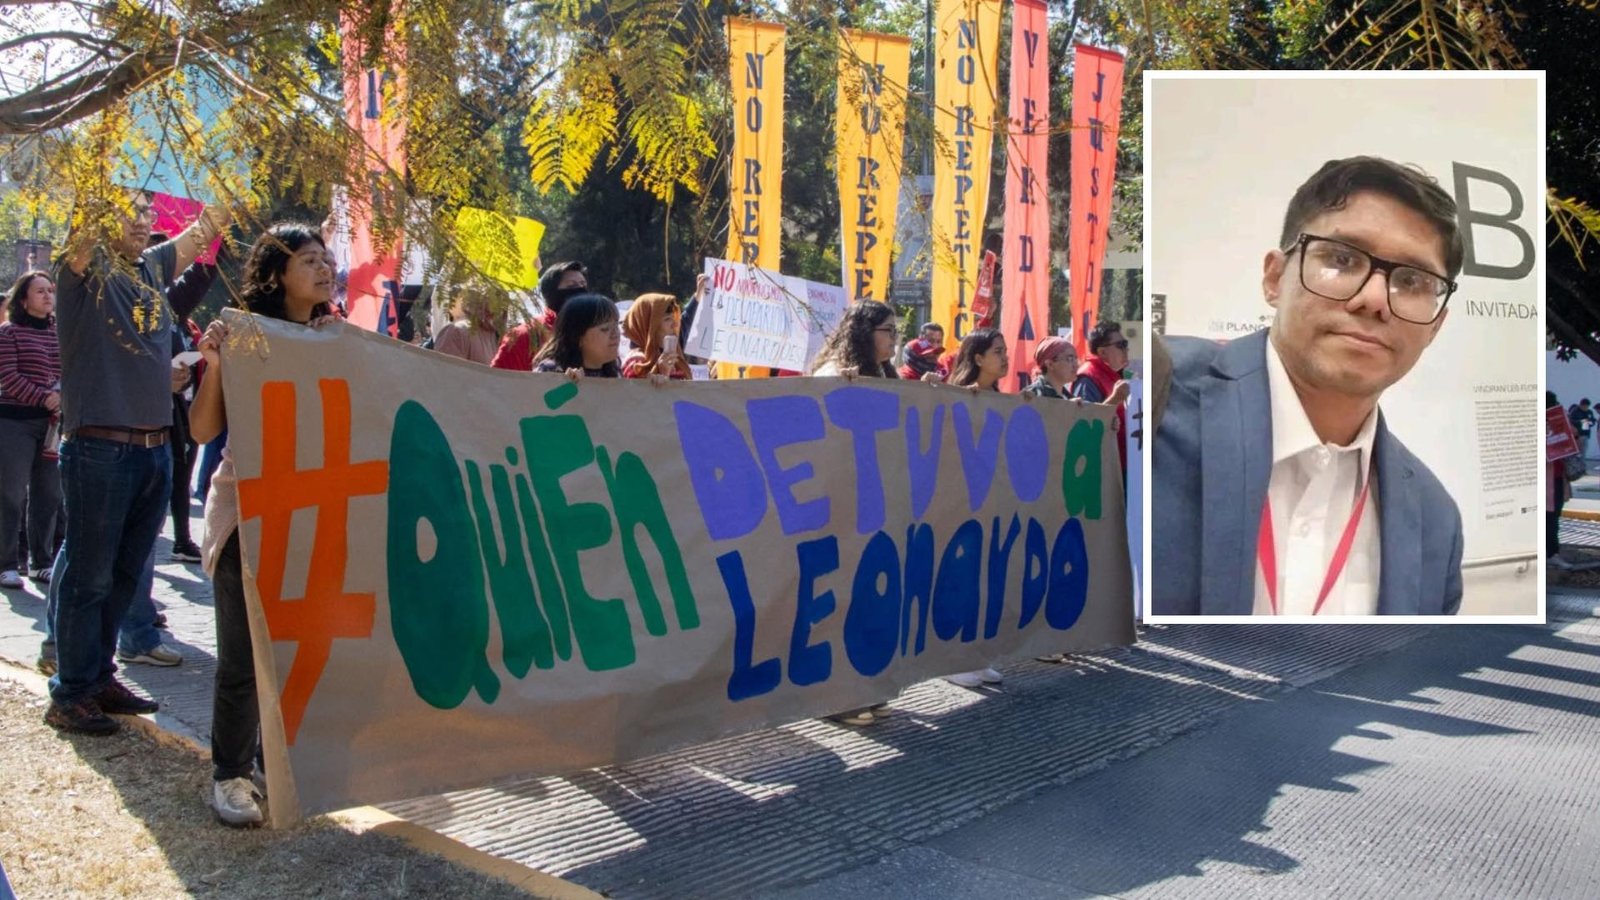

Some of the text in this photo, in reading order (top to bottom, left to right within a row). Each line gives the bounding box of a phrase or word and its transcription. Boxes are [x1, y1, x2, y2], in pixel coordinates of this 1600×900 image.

[958, 19, 976, 85] NO
[745, 52, 764, 133] NO
[859, 62, 885, 135] NO
[1452, 161, 1536, 280] B
[713, 264, 736, 292] NO
[1466, 300, 1537, 319] INVITADA
[674, 386, 1049, 541] DETUVO
[1062, 418, 1105, 520] a
